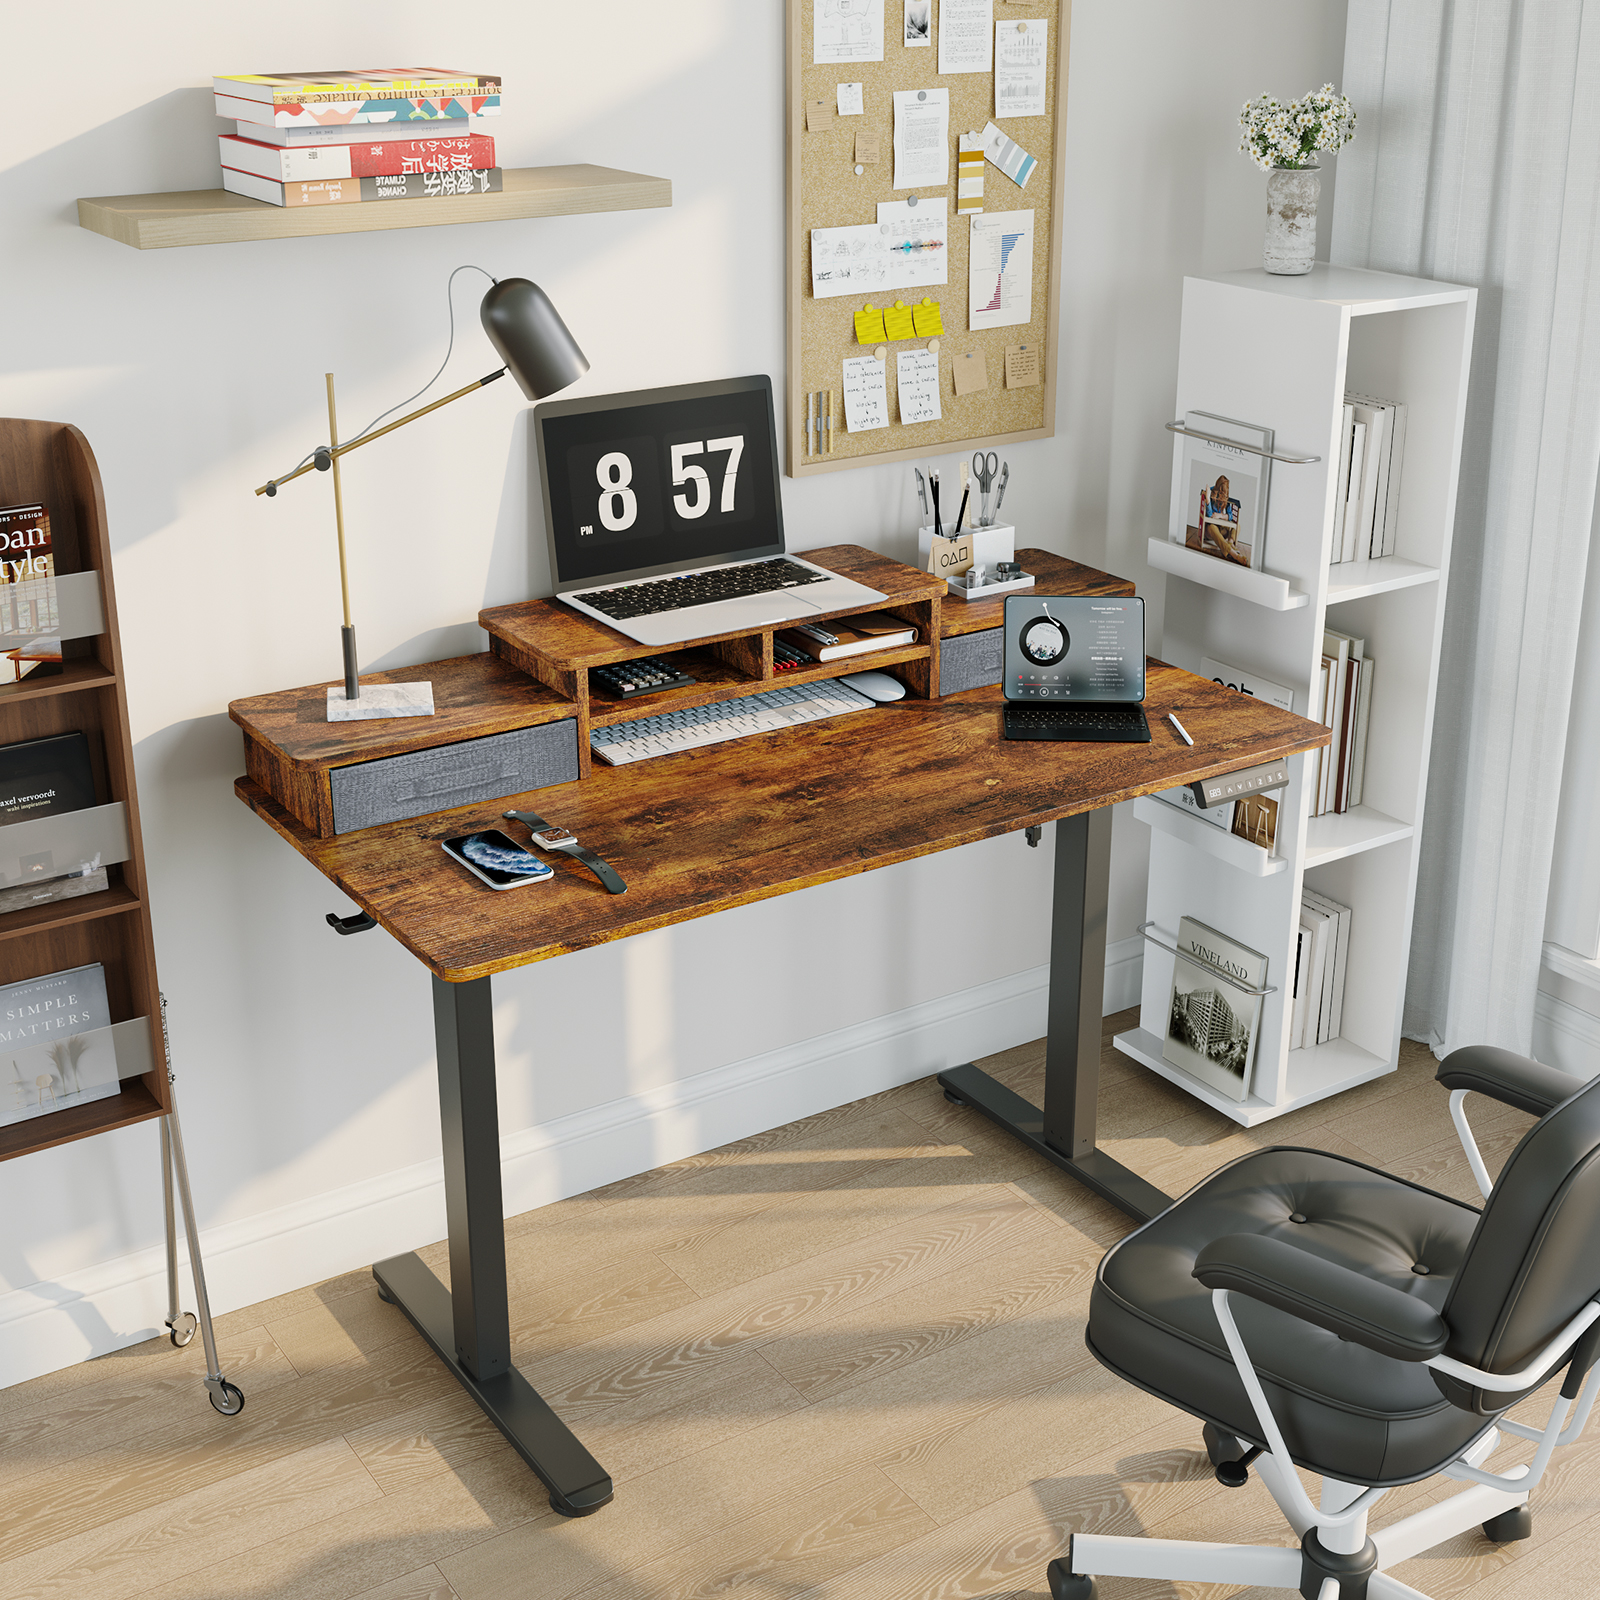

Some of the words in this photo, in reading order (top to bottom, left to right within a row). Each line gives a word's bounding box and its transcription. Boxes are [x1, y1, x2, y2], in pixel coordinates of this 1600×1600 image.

[596, 452, 638, 532] 8
[670, 435, 745, 520] 57
[19, 512, 43, 520] DESIGN
[580, 525, 594, 536] PM
[1191, 941, 1248, 979] VINELAND
[11, 988, 33, 998] JENNY
[35, 980, 67, 991] MUSTARD
[6, 994, 78, 1021] SIMPLE
[0, 1010, 91, 1043] MATTERS
